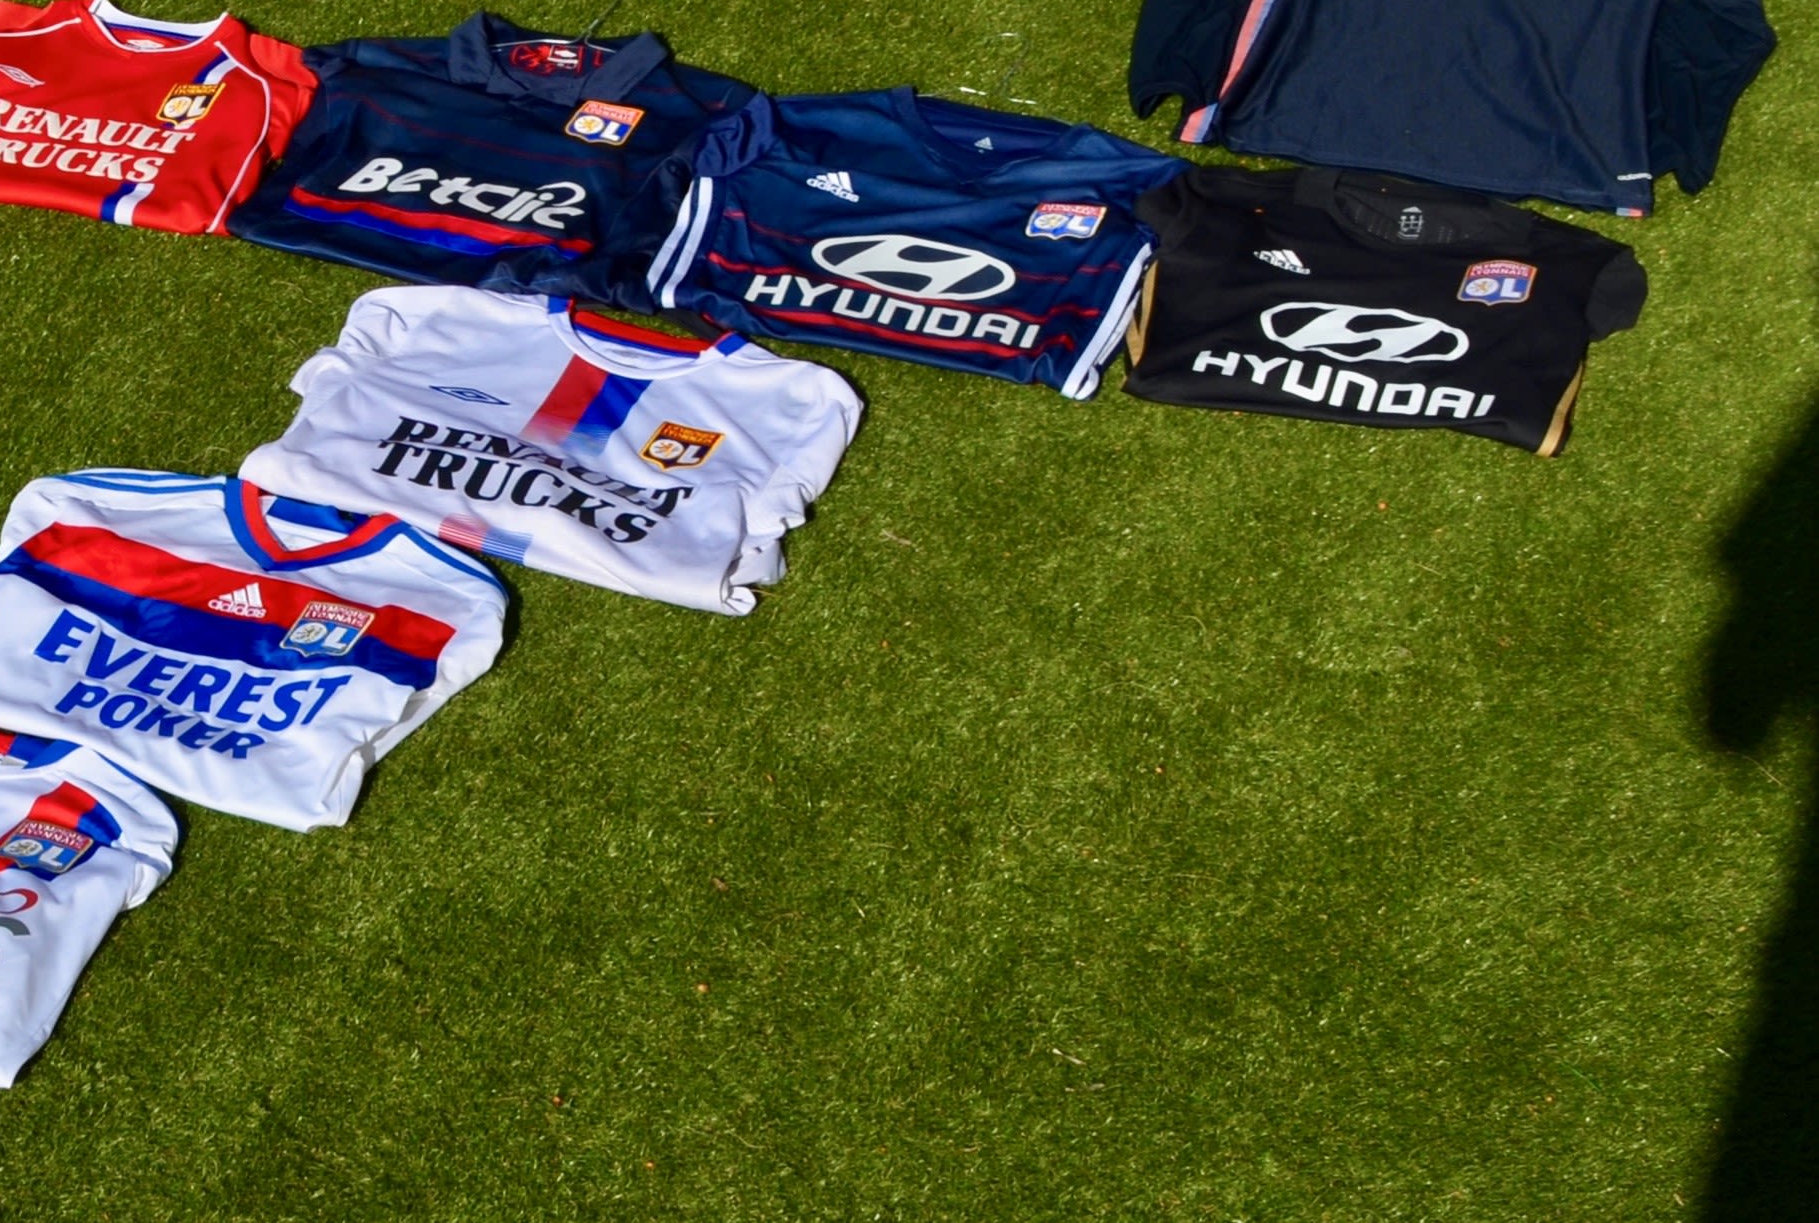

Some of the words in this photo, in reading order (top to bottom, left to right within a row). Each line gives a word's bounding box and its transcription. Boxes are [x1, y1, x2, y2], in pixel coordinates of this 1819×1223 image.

[163, 95, 207, 118] OL
[573, 114, 621, 142] OL
[806, 178, 860, 203] adidas
[1033, 213, 1090, 233] OL
[1465, 277, 1522, 298] OL
[744, 274, 1039, 351] HYUNDAI
[1192, 350, 1495, 420] HYUNDAI
[649, 438, 700, 464] OL
[390, 416, 694, 517] RENAULT
[372, 439, 657, 544] TRUCKS
[208, 598, 267, 619] adidas
[289, 622, 348, 649] OL
[34, 609, 349, 731] EVEREST
[55, 682, 265, 760] POKER
[3, 839, 64, 866] OL
